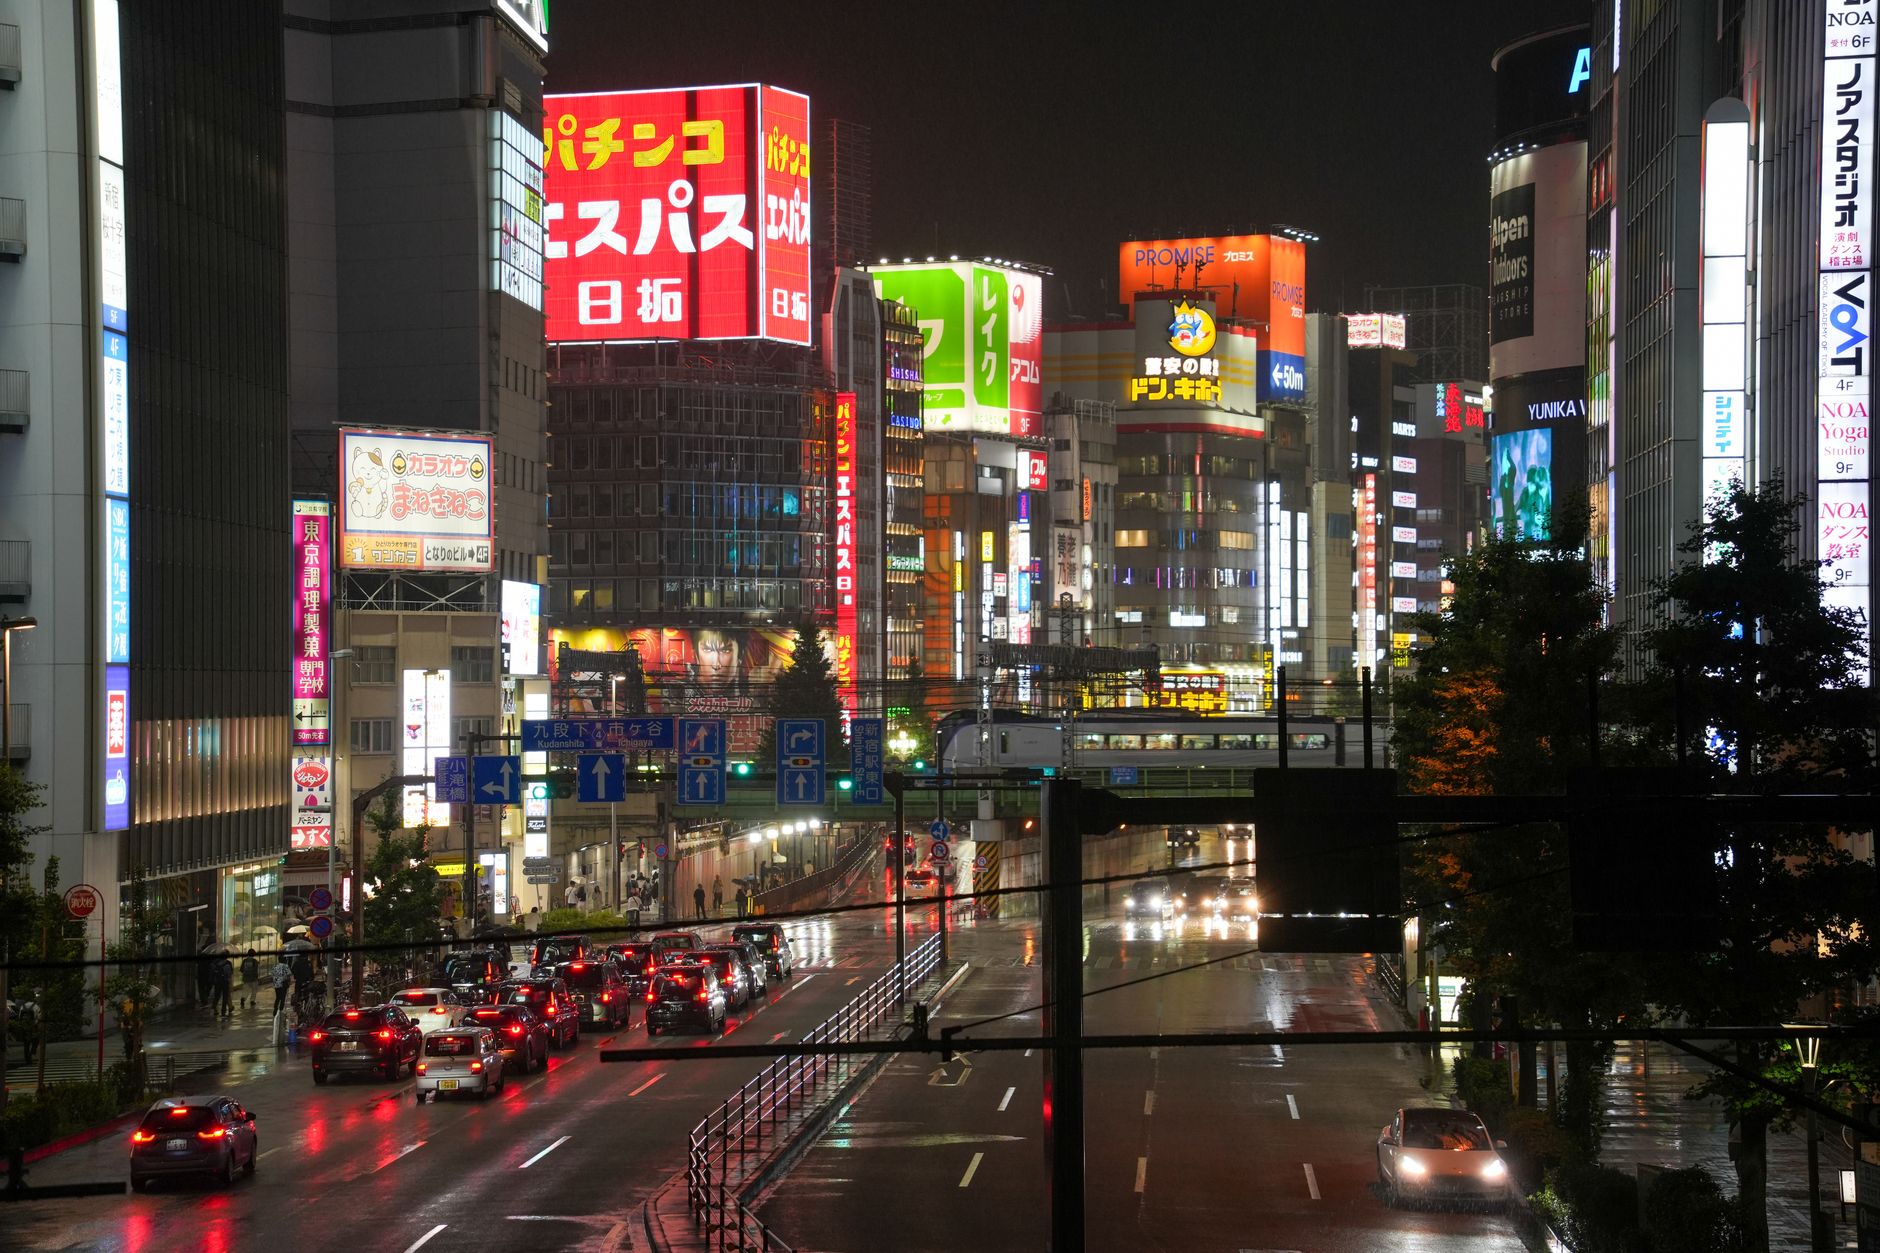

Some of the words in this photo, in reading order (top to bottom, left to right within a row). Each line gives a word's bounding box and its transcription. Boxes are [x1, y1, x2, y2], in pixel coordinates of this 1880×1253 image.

[1828, 10, 1875, 27] NOA
[1830, 39, 1848, 48] 受付
[1851, 34, 1871, 48] 6F
[543, 113, 724, 171] パチンコ
[1834, 62, 1862, 228] ノアスタジオ
[767, 126, 810, 179] パチンコ
[544, 179, 753, 258] エスパス
[766, 187, 810, 244] エスパス
[1492, 214, 1529, 252] Alpen
[1834, 231, 1858, 242] 演劇
[1135, 246, 1215, 267] PROMISE
[1223, 251, 1255, 263] プロミス
[1830, 244, 1862, 254] ダンス
[1829, 255, 1863, 267] 稽古場
[1493, 254, 1528, 287] Outdoors
[1271, 281, 1303, 306] PROMISE
[1500, 304, 1529, 320] STORE
[982, 275, 997, 386] レイク
[110, 337, 119, 356] 4F
[891, 368, 919, 380] SHISHA
[1011, 357, 1040, 384] アコム
[1283, 365, 1303, 391] 50m
[1835, 379, 1854, 391] 4F
[1528, 400, 1577, 421] YUNIKA
[1821, 402, 1868, 418] NOA
[891, 414, 920, 429] CASINO
[1020, 418, 1030, 433] 3F
[1392, 422, 1416, 437] DARTS
[1821, 424, 1868, 443] Yoga
[1824, 445, 1865, 456] Studio
[408, 452, 469, 477] カラオケ
[1835, 461, 1854, 473] 9F
[390, 480, 486, 521] まねきねこ
[113, 507, 127, 527] SBC
[1820, 502, 1868, 519] NOA
[1821, 524, 1869, 541] ダンス
[371, 549, 418, 563] ワンカラ
[425, 545, 468, 561] となりのビル
[477, 546, 488, 563] 4F
[1826, 543, 1861, 559] 教室
[1835, 568, 1853, 581] 9F
[304, 520, 320, 658] 東京調理製菓
[299, 660, 324, 677] 専門
[299, 677, 324, 693] 学校
[298, 731, 324, 740] 50m先右
[533, 722, 591, 738] 九段下
[537, 740, 585, 749] Kudanshita
[618, 740, 653, 748] Ichigaya
[854, 725, 865, 764] Shinjuku
[865, 723, 879, 800] 新宿駅東口
[449, 759, 465, 800] 小滝橋
[297, 816, 324, 824] バーミヤン
[306, 827, 330, 845] すぐ
[71, 897, 94, 908] 消火栓
